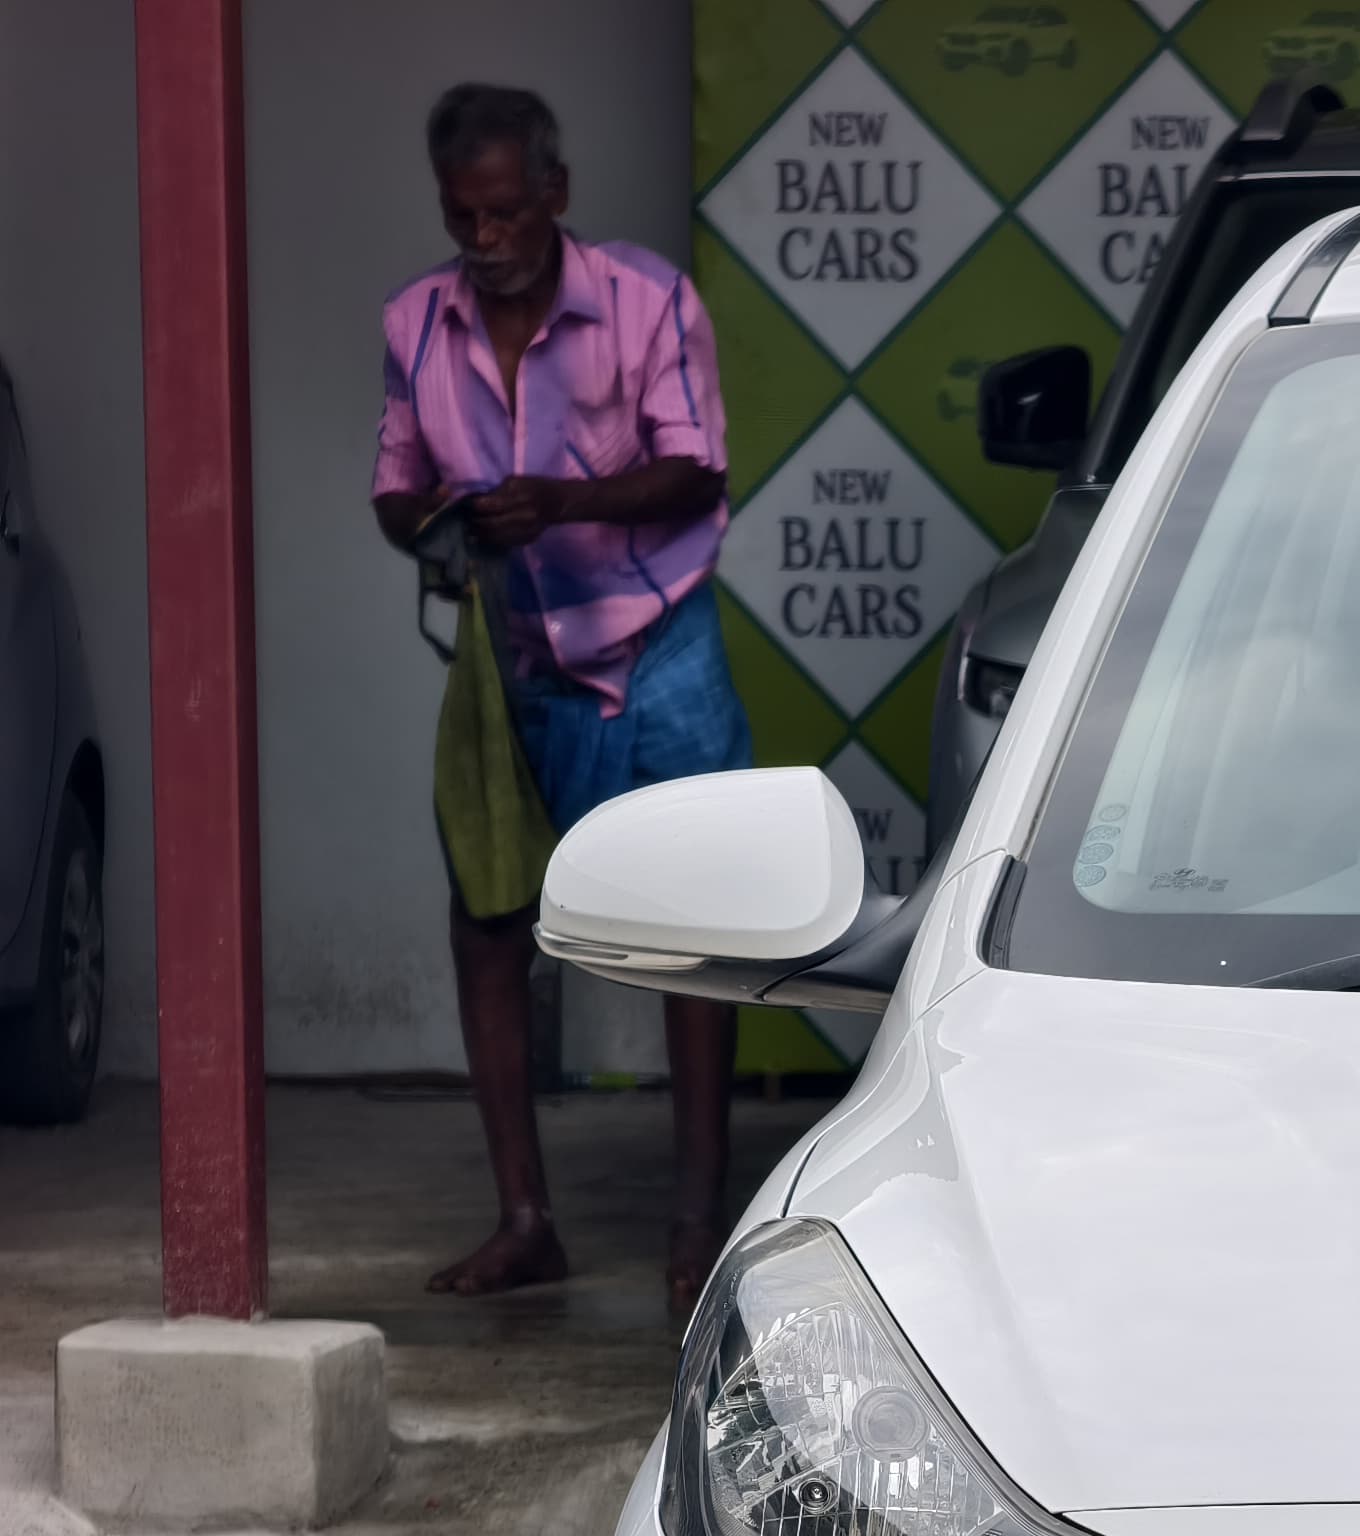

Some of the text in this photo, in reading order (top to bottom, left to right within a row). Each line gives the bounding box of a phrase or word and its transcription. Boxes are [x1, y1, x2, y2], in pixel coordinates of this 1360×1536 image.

[808, 111, 888, 148] NEW
[1131, 115, 1211, 150] NEW
[775, 159, 922, 215] BALU
[776, 227, 920, 283] CARS
[813, 468, 891, 505] NEW
[780, 516, 926, 573] BALU
[783, 584, 923, 640] CARS
